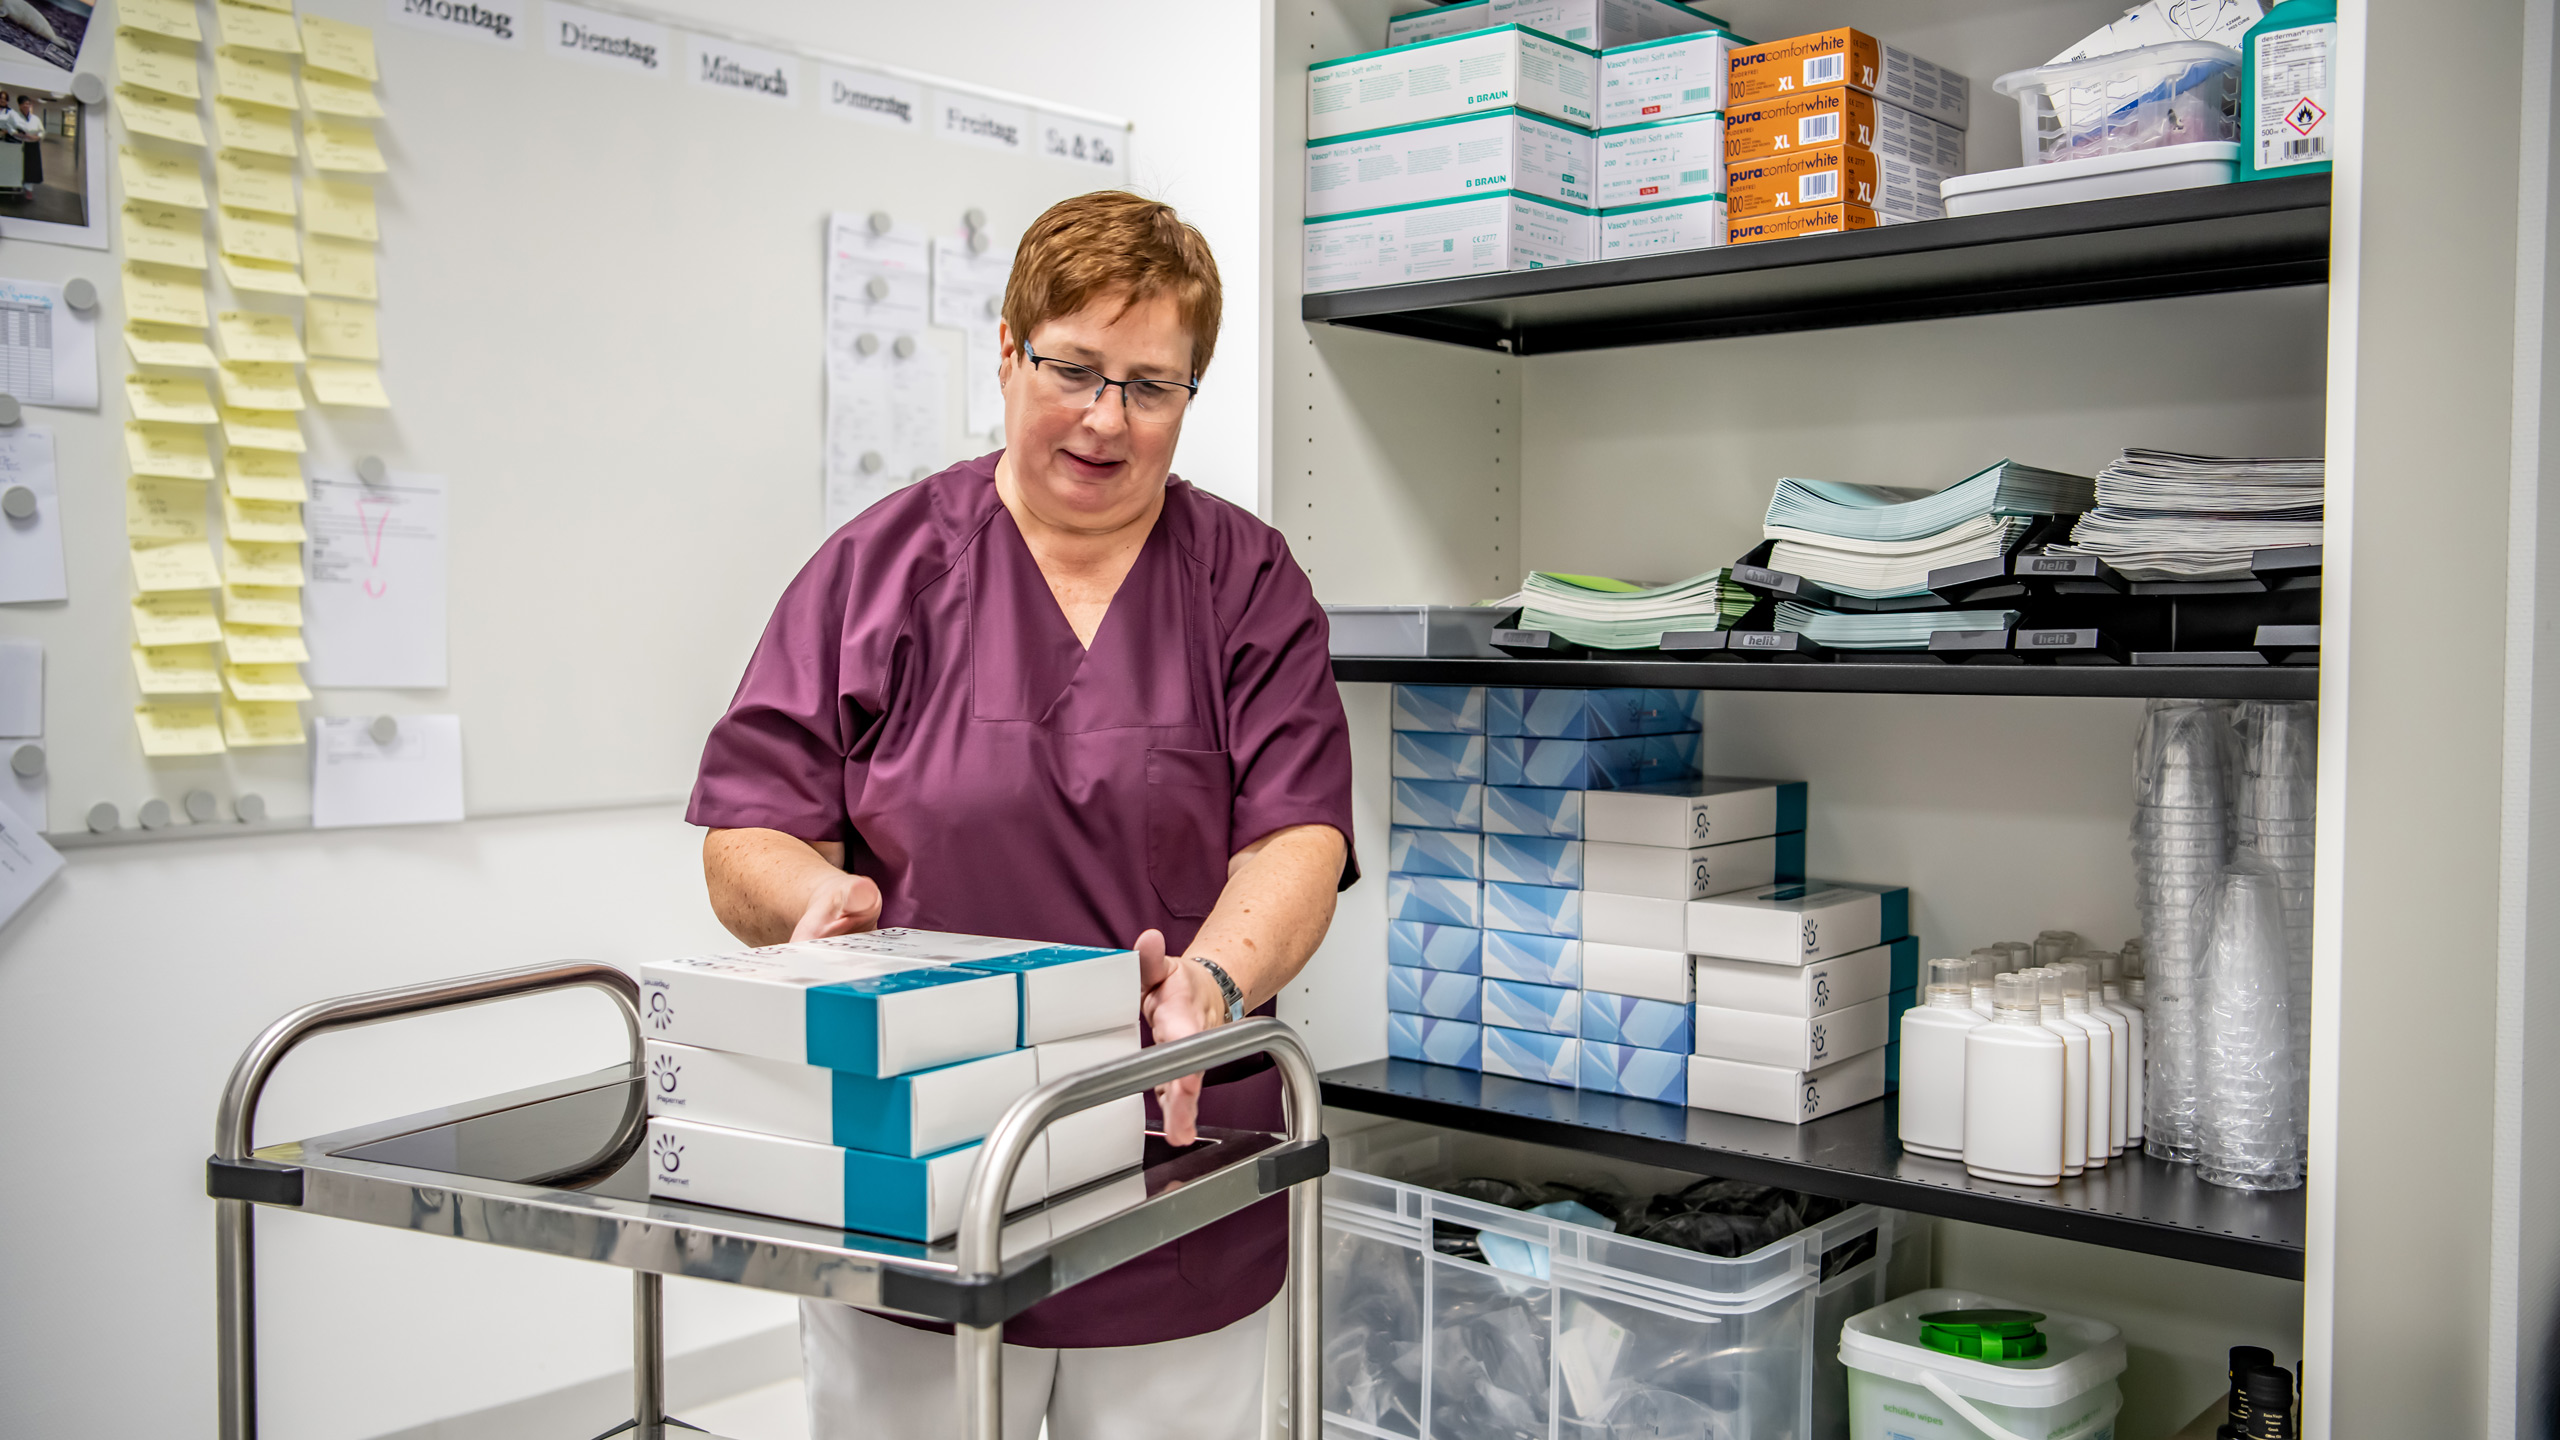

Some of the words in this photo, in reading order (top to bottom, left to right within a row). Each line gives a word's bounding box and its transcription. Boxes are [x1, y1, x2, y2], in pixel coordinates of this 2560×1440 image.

[404, 0, 513, 39] Montag
[560, 20, 658, 69] Dienstag
[701, 52, 787, 97] Mittwoch
[1861, 65, 1874, 88] XL
[1730, 81, 1745, 99] 100
[1778, 76, 1795, 91] XL
[1468, 96, 1474, 104] B
[1477, 90, 1508, 103] BRAUN
[1570, 106, 1591, 119] BRAUN
[945, 107, 1019, 146] Freitag
[1774, 134, 1790, 150] XL
[1858, 124, 1871, 146] XL
[1726, 139, 1740, 157] 100
[1466, 179, 1472, 187] B
[1475, 175, 1506, 186] BRAUN
[1567, 189, 1588, 201] BRAUN
[1775, 192, 1791, 207] XL
[1858, 181, 1871, 203] XL
[1729, 196, 1743, 213] 100
[1482, 234, 1497, 243] 2777
[2038, 560, 2070, 570] helit
[1752, 571, 1775, 585] helit
[1748, 635, 1775, 646] helit
[2038, 633, 2069, 644] helit
[1917, 1413, 1944, 1426] wipes
